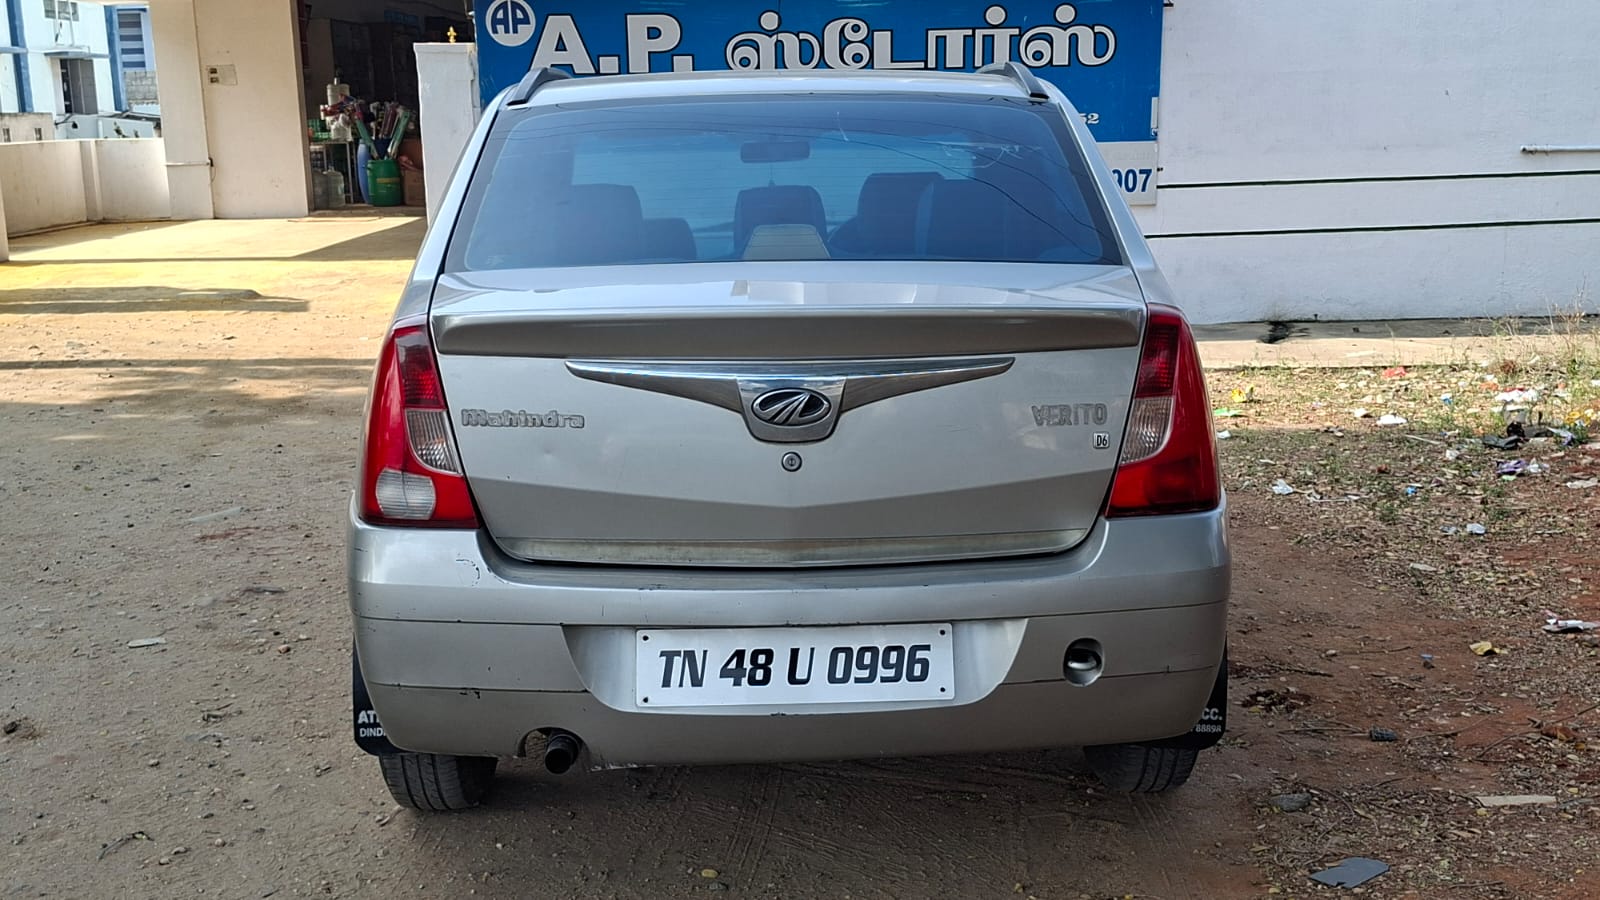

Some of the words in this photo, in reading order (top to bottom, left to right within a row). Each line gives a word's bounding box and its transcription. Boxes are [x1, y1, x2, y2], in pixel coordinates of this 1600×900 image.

[491, 0, 531, 35] AP
[529, 13, 693, 74] A.P.
[725, 10, 1116, 71] ஸ்டோர்ஸ்
[461, 408, 585, 428] Mahindra
[1031, 402, 1108, 427] VERITO
[658, 649, 708, 689] TN
[718, 648, 775, 688] 48
[786, 647, 816, 686] U
[827, 644, 931, 684] 0996
[358, 710, 379, 724] AT
